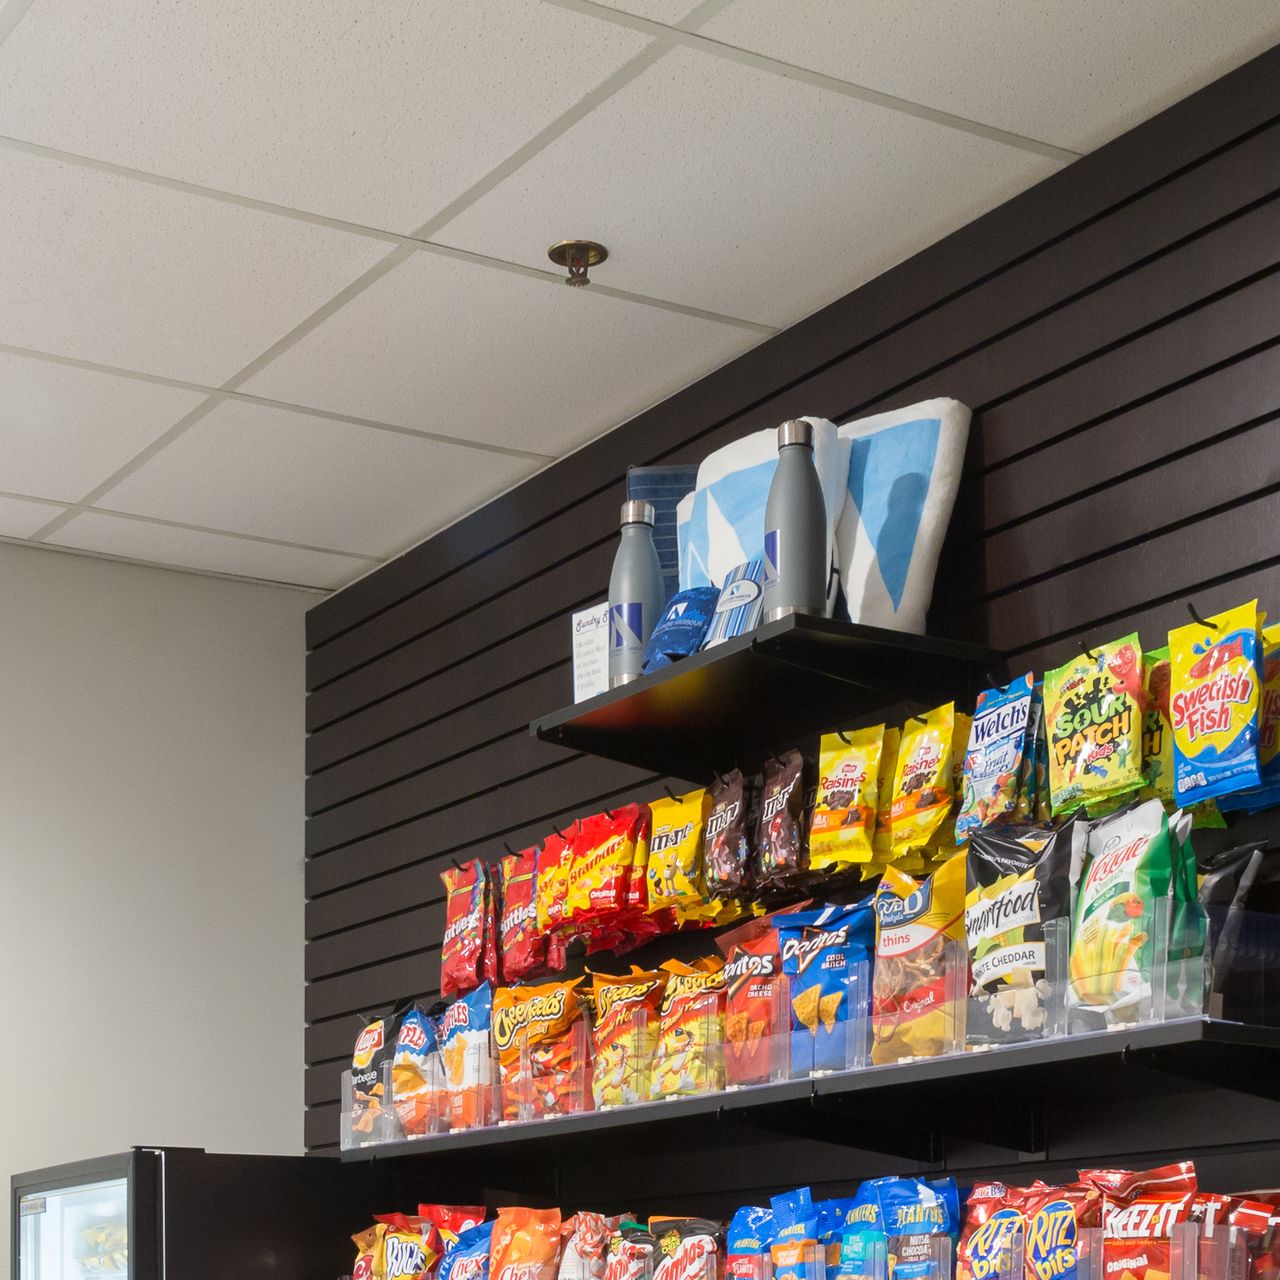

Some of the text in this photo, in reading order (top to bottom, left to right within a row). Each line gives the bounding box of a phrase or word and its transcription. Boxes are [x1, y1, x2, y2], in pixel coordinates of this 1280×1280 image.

[1056, 693, 1126, 738] SOUR
[1172, 669, 1253, 729] Swedish
[974, 701, 1027, 742] Welch's
[1055, 709, 1131, 767] PATCH
[1186, 707, 1231, 743] Fish
[1086, 836, 1151, 891] Veggie
[589, 889, 617, 900] Original
[782, 925, 849, 962] Doritos
[883, 932, 911, 948] thins
[821, 960, 846, 970] RANCH
[825, 953, 846, 962] COOL
[992, 950, 1036, 968] CHEDDAR
[747, 990, 773, 998] CHEESE
[749, 983, 773, 992] NACHO
[903, 992, 934, 1013] Original
[1028, 1208, 1077, 1262] RITZ
[1103, 1201, 1185, 1239] CHEEZ-IT
[971, 1250, 1010, 1280] bits
